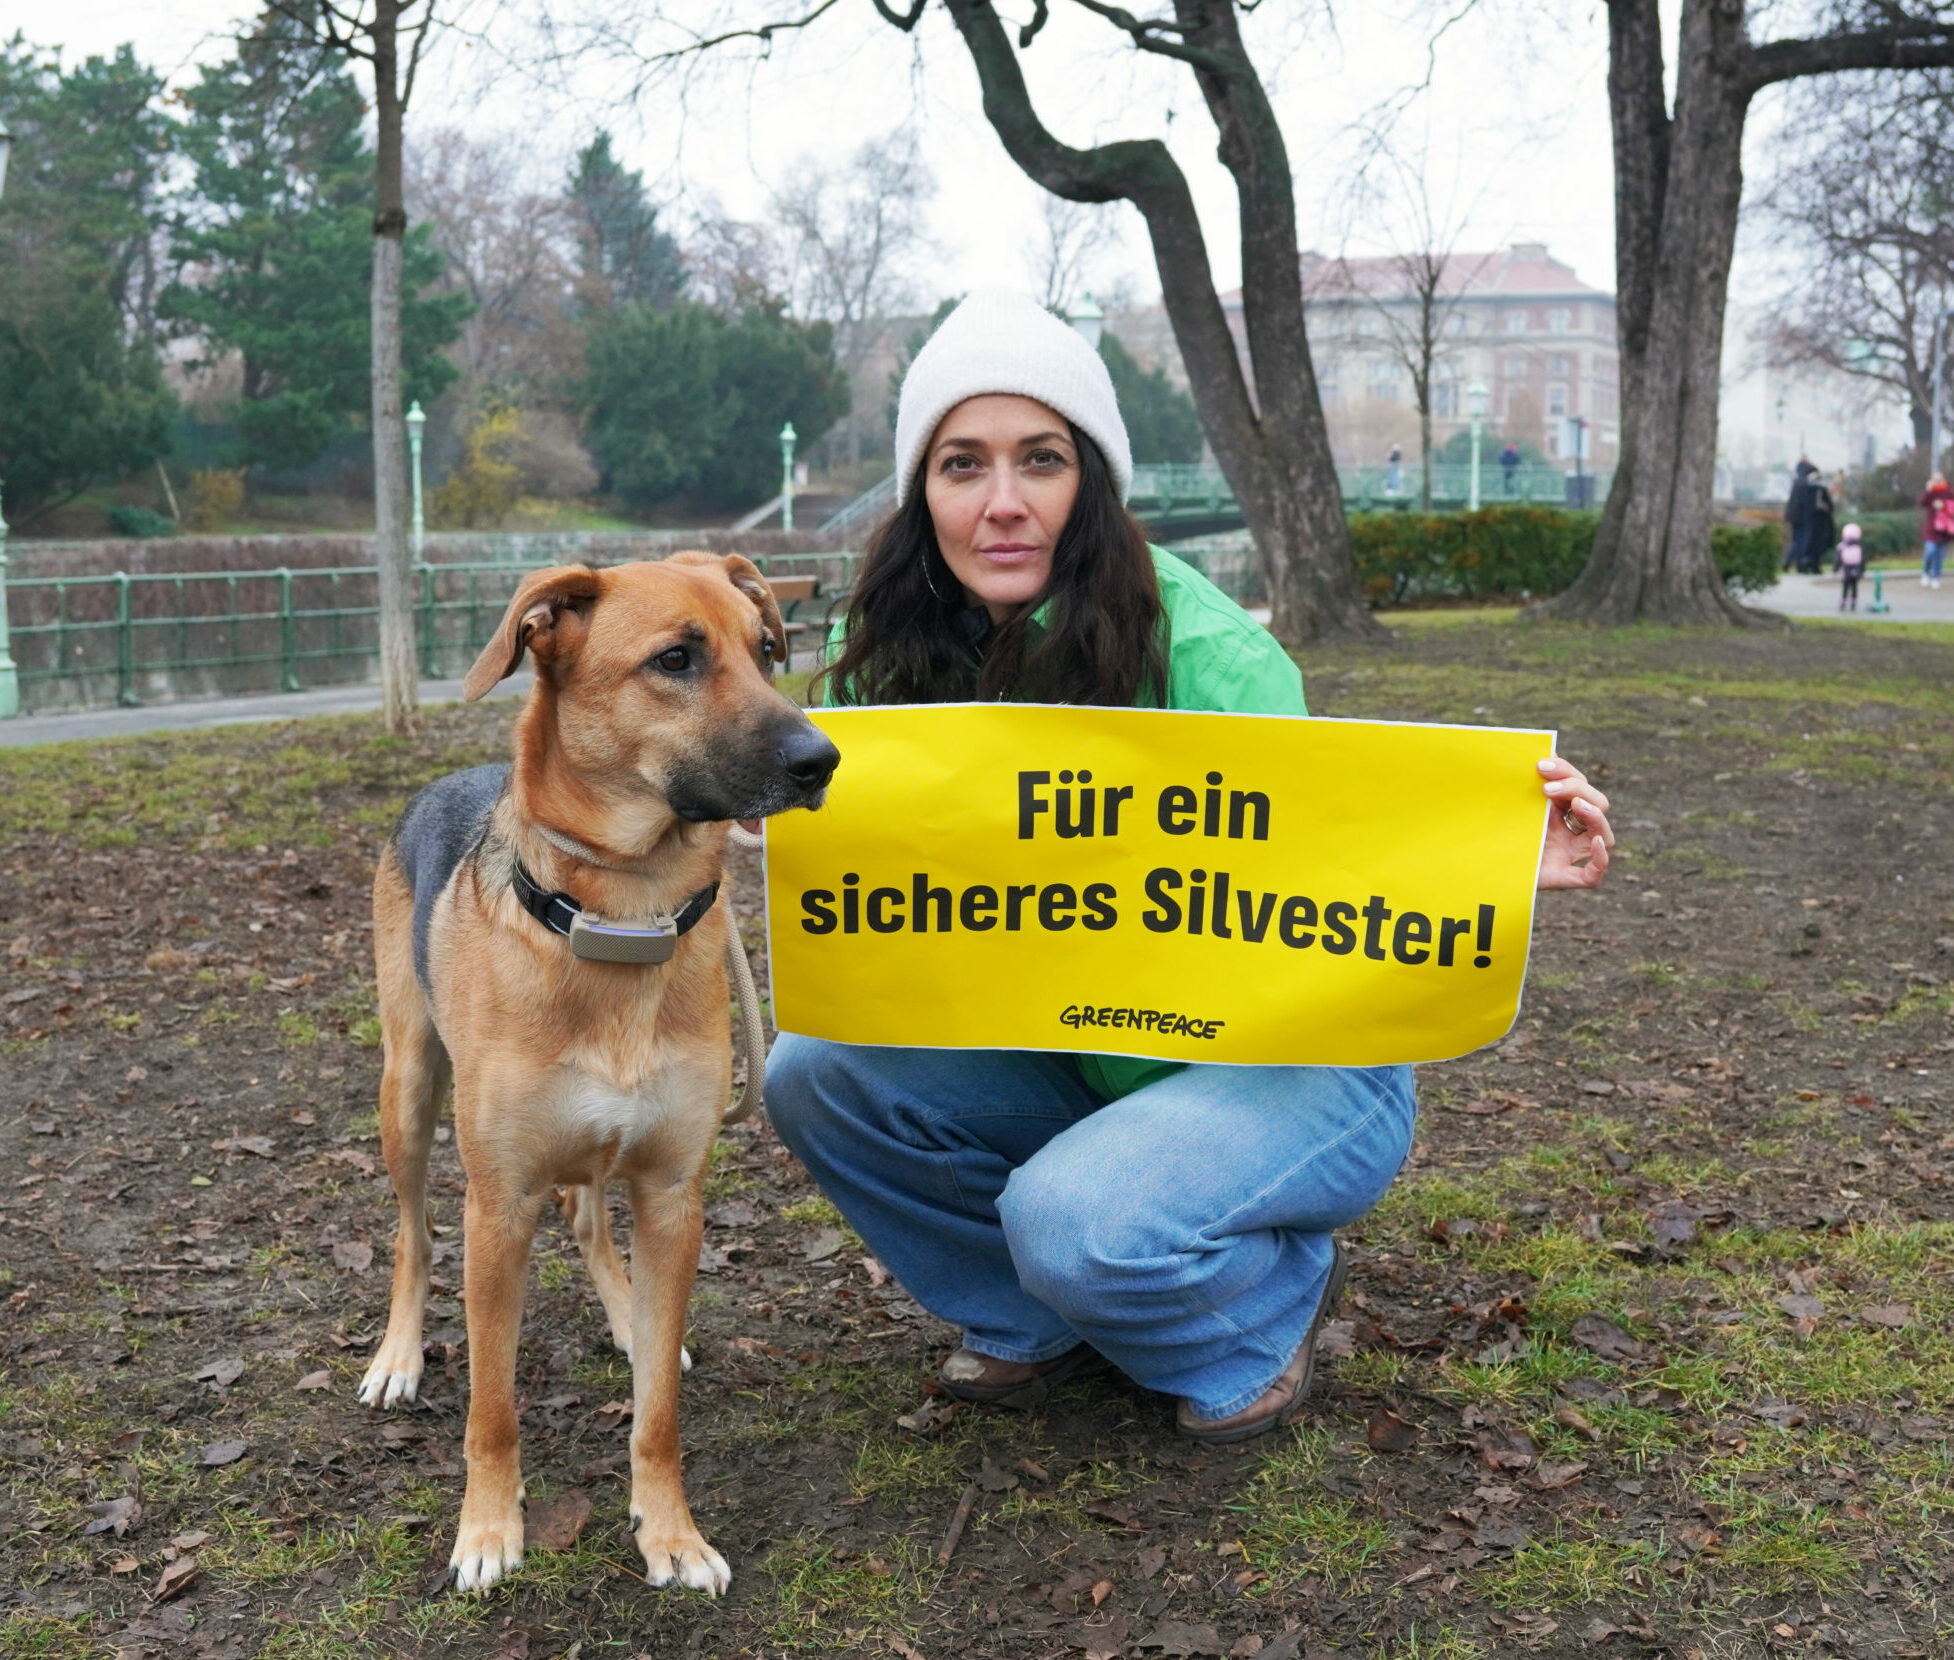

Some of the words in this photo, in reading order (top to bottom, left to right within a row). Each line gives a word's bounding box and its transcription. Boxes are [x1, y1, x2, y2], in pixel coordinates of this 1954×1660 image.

[1018, 769, 1134, 840] Für
[1157, 771, 1270, 841] ein
[800, 872, 1118, 935] sicheres
[1142, 867, 1496, 969] Silvester!
[1059, 1005, 1225, 1040] GREENPEACE
